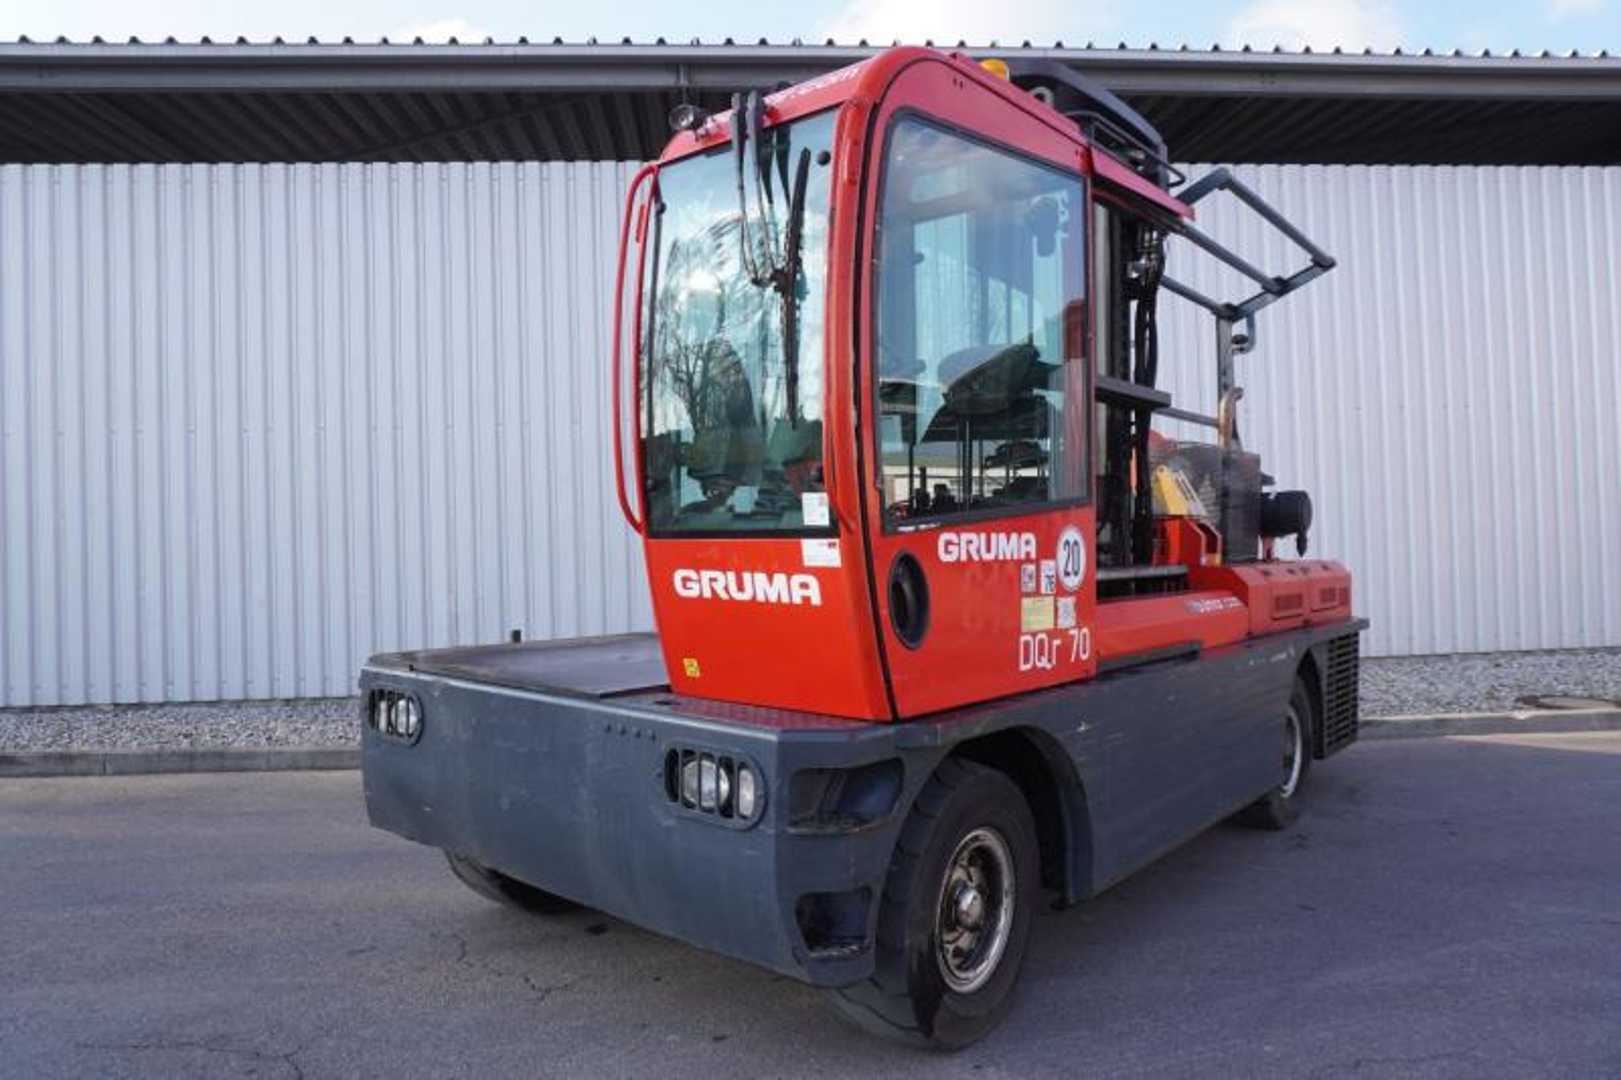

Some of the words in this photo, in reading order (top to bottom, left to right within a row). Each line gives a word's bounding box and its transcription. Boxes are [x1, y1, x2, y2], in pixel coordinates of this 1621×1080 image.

[938, 532, 1036, 562] GRUMA
[1063, 539, 1080, 577] 20
[673, 568, 822, 606] GRUMA
[1069, 627, 1090, 662] 70
